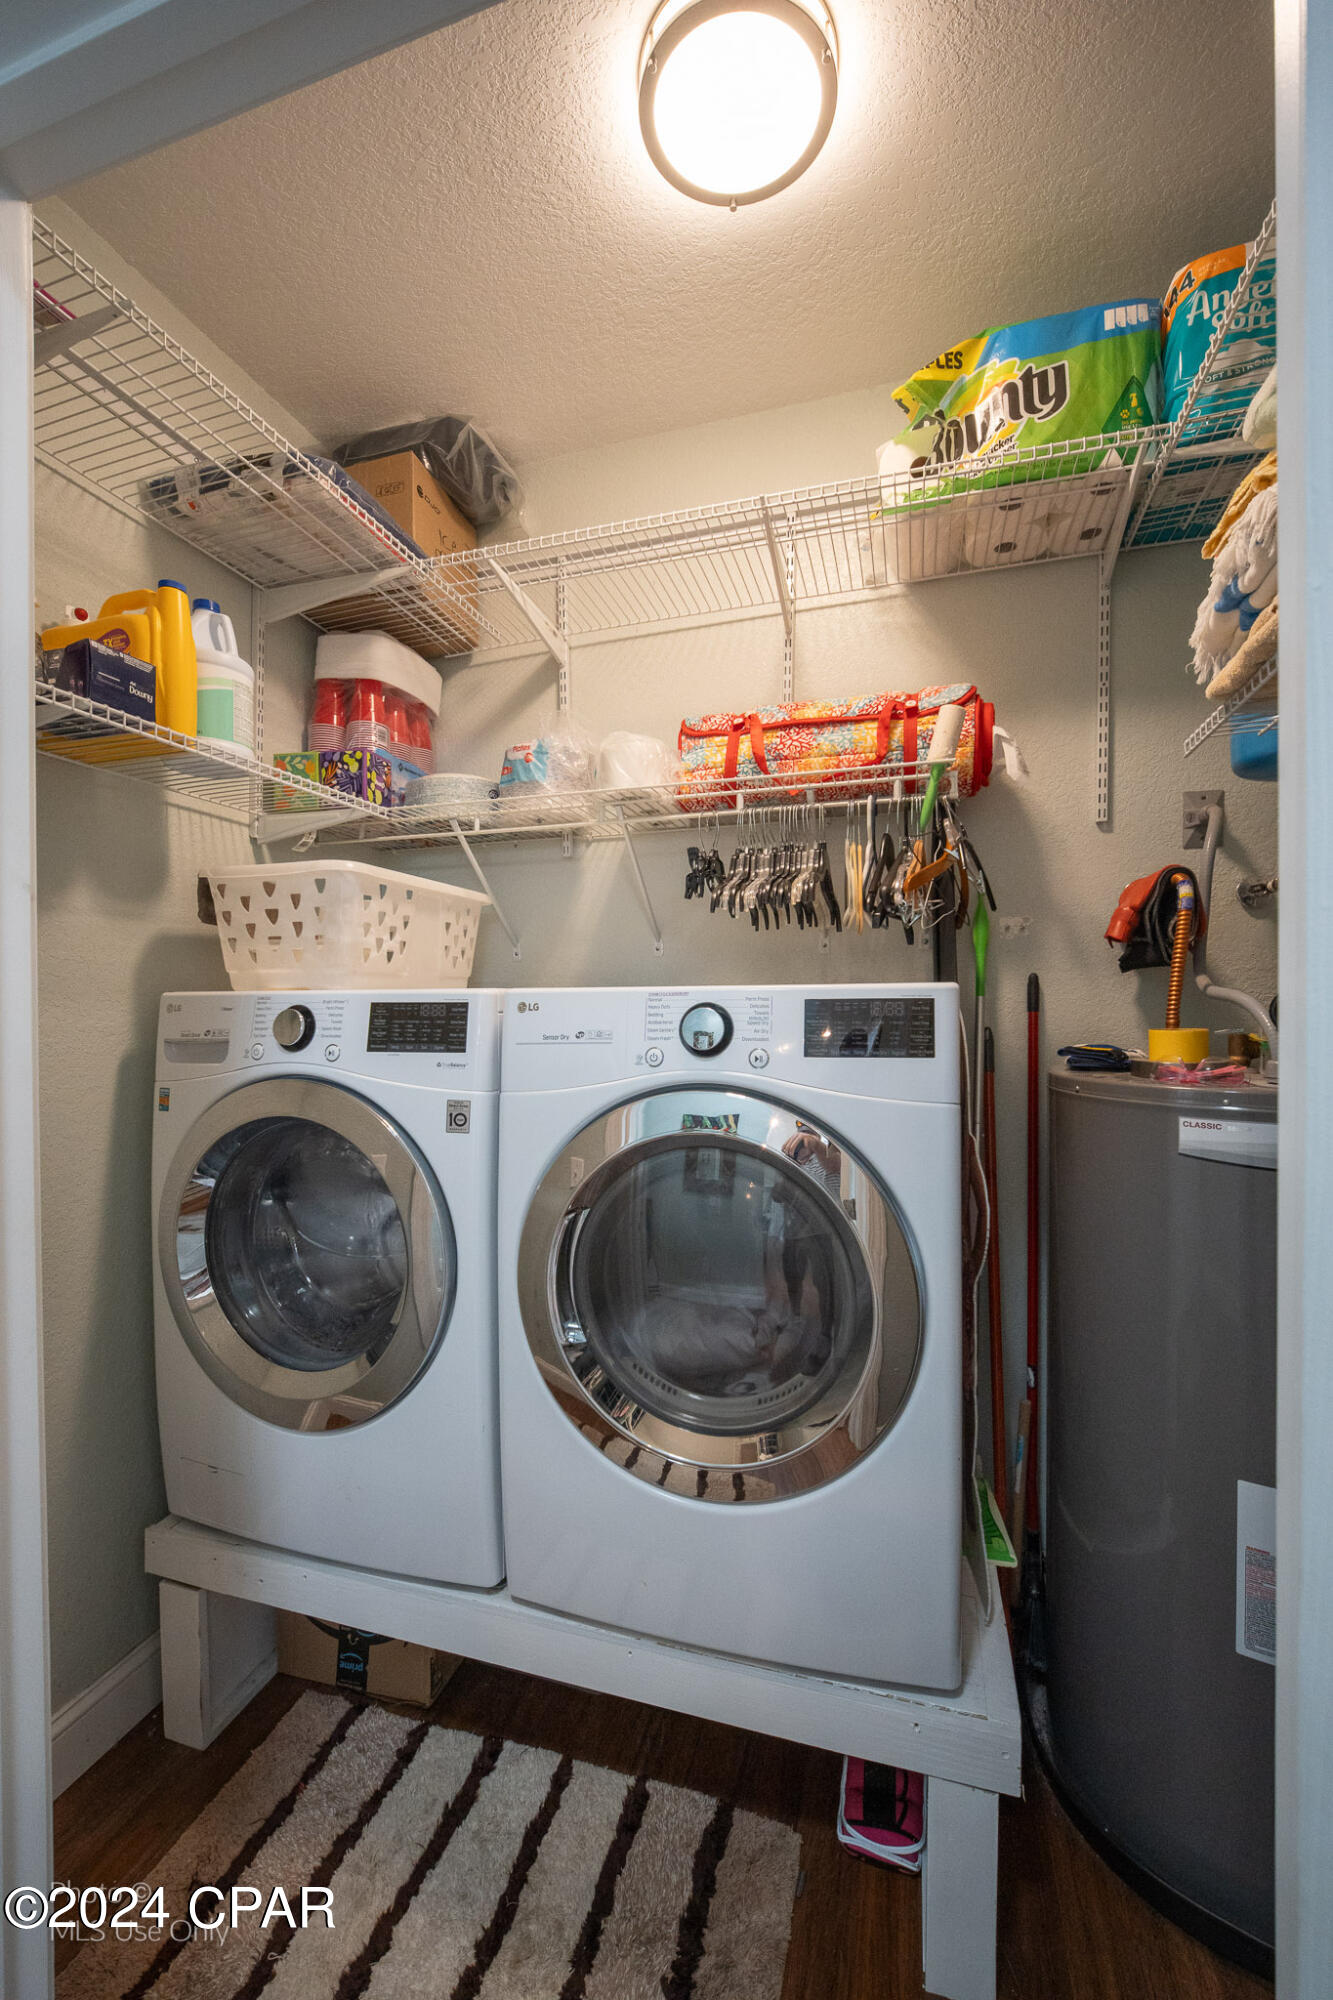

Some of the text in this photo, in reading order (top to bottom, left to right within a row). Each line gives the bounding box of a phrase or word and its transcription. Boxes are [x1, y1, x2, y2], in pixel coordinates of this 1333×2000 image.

[1204, 371, 1225, 383] OFT
[129, 685, 154, 704] Downy
[528, 1002, 540, 1012] LG
[560, 1034, 570, 1042] Dry
[449, 1112, 467, 1128] 10
[1182, 1120, 1223, 1131] CLASSIC
[339, 1660, 364, 1673] prime
